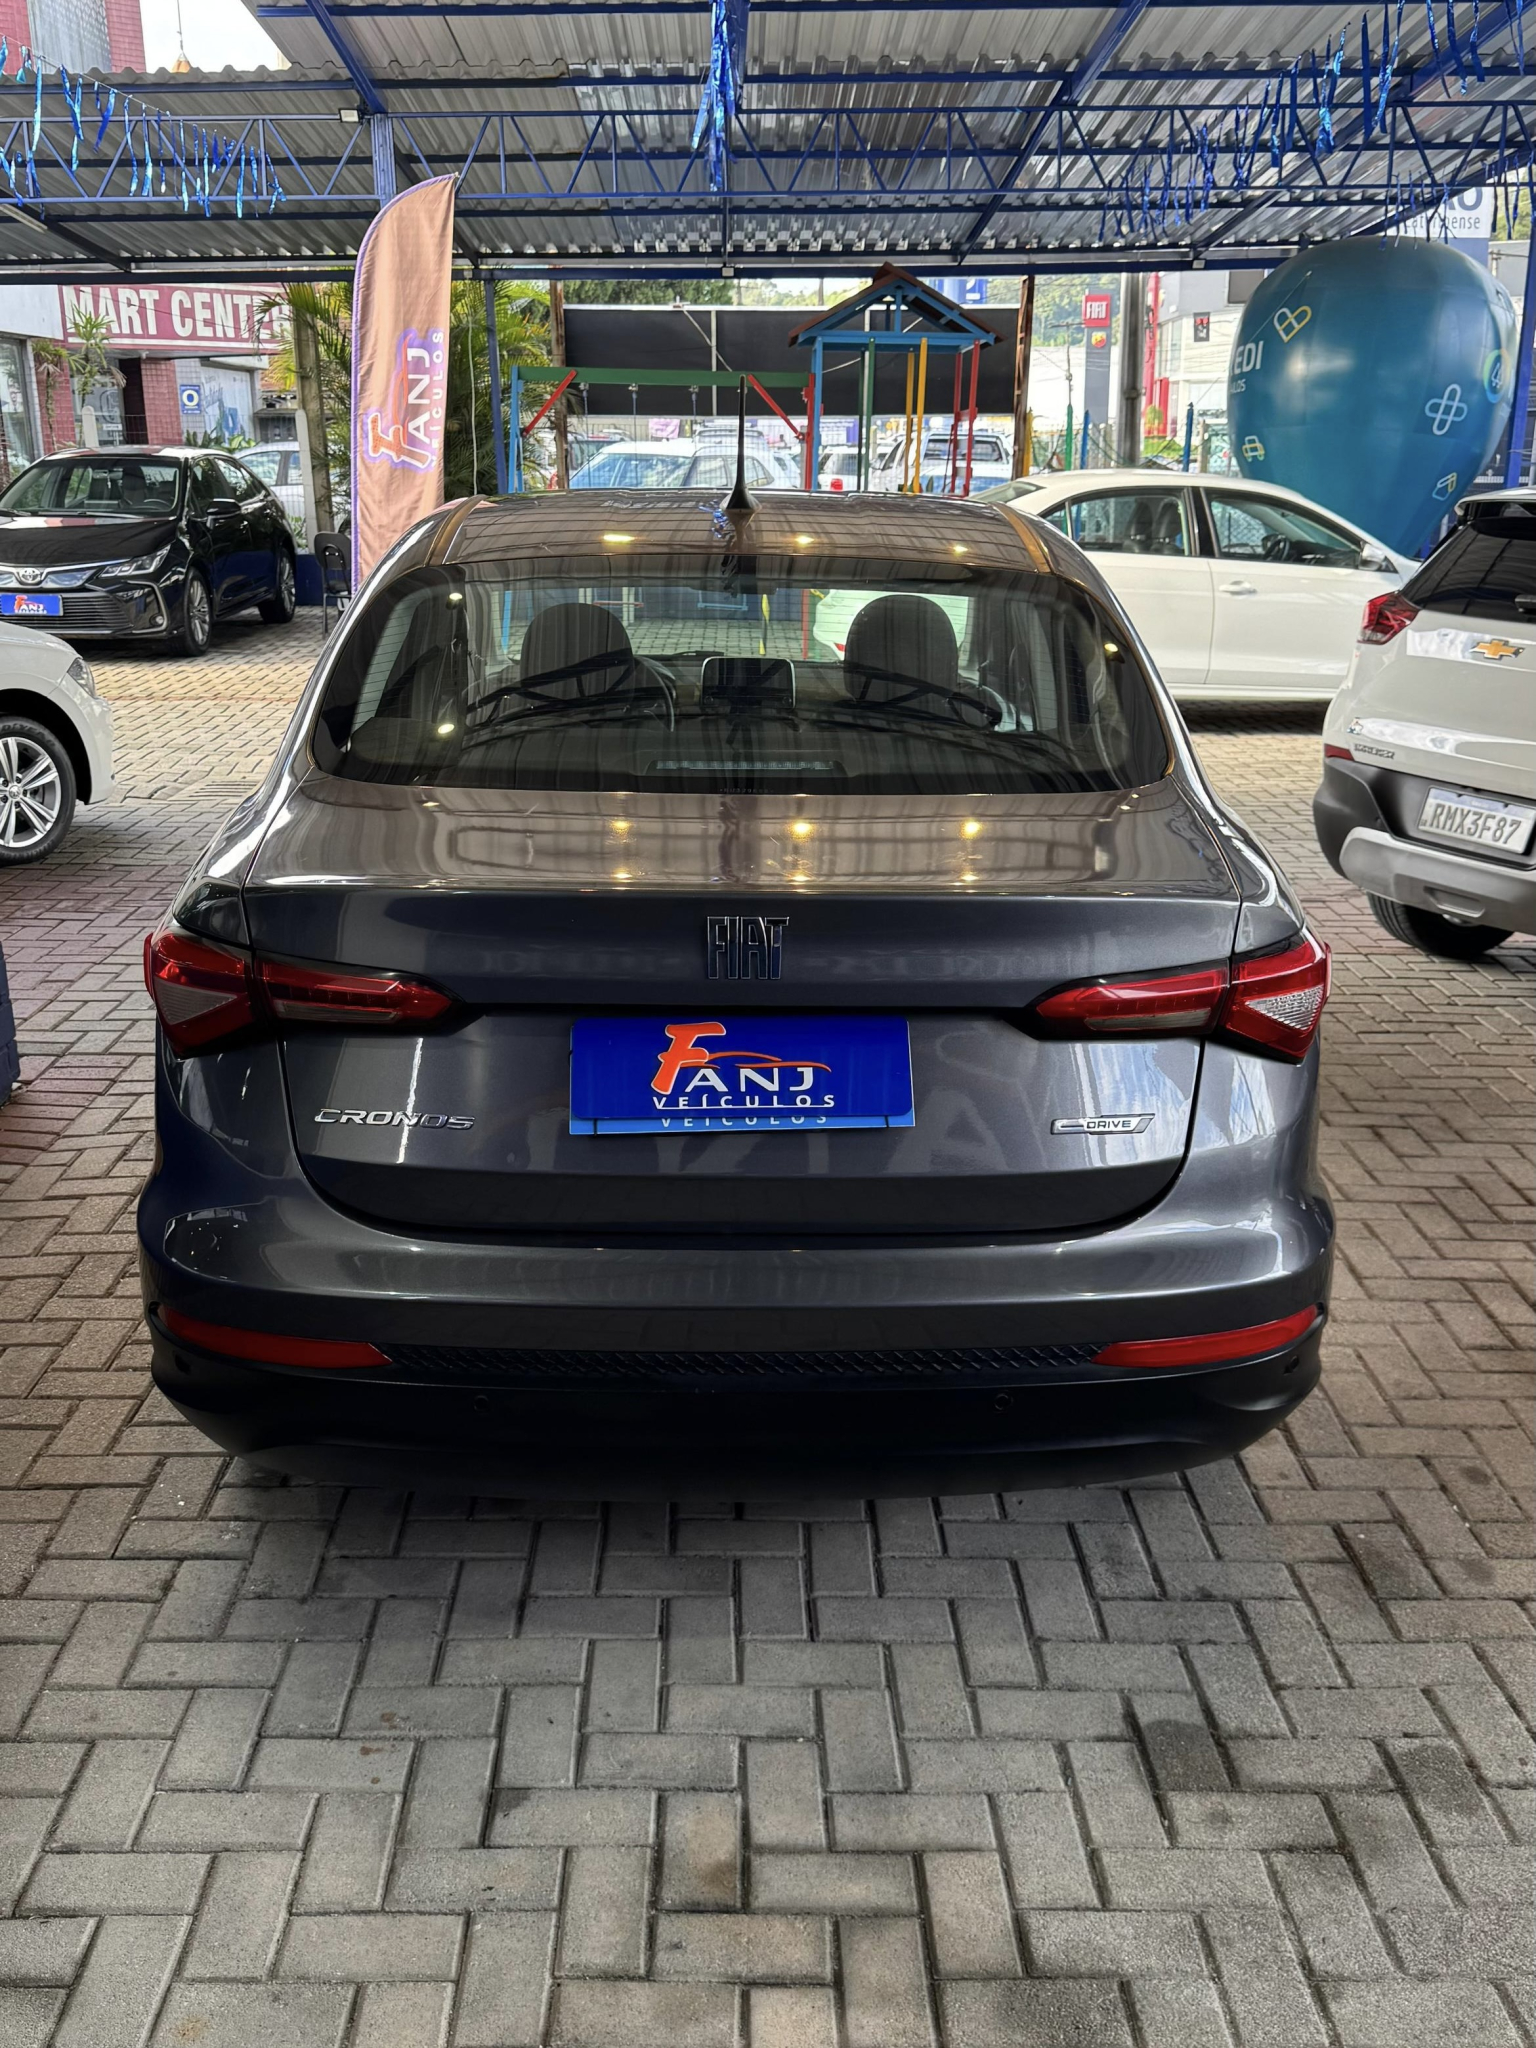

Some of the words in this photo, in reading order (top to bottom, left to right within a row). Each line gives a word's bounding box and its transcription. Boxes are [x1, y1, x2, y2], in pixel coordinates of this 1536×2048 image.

[63, 284, 159, 335] MART
[1086, 301, 1108, 319] FIAT
[1429, 803, 1522, 845] RMX3F87
[707, 916, 789, 979] FIAT
[651, 1021, 814, 1095] FANJ
[652, 1094, 835, 1109] VEÍCULOS
[314, 1108, 475, 1129] CRONOS
[1086, 1120, 1131, 1129] DRIVE
